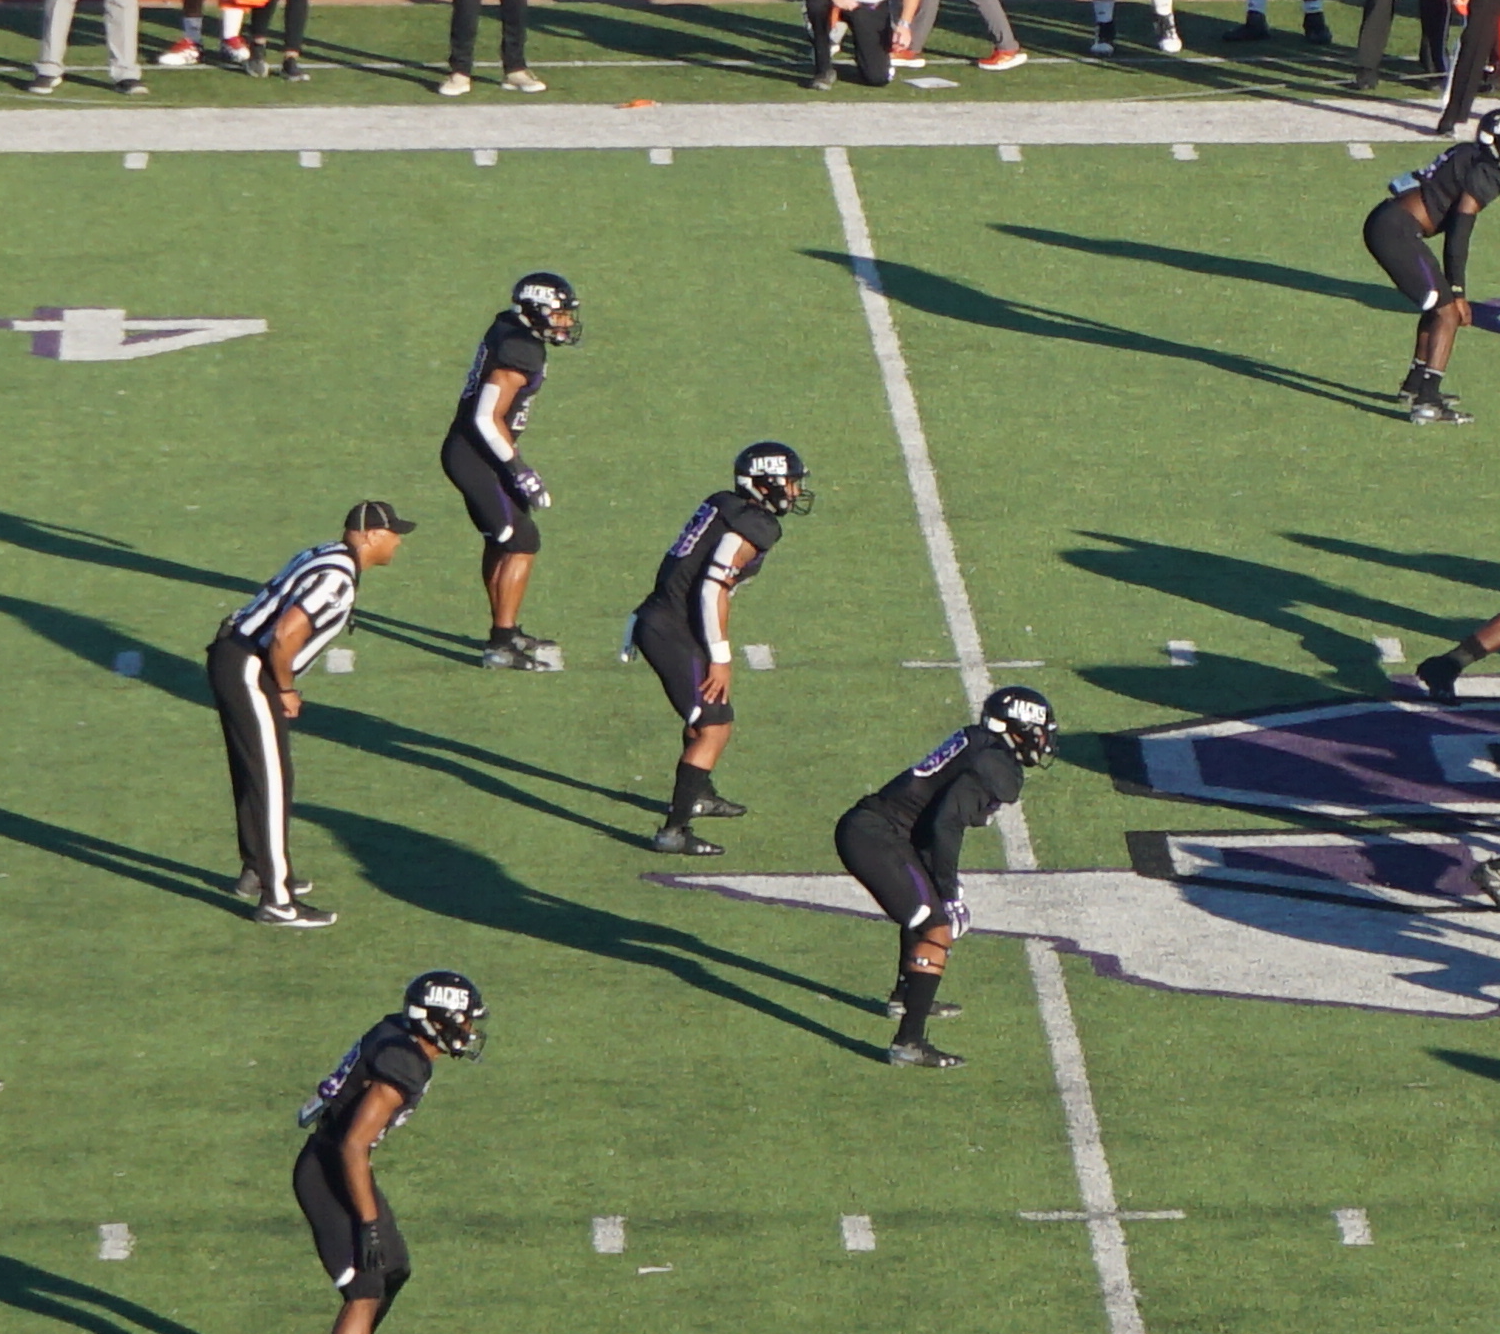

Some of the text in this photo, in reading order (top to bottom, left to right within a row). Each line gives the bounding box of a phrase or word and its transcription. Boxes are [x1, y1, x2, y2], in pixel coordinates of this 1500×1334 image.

[749, 455, 789, 476] JACKS
[1007, 701, 1049, 726] JACKS
[424, 987, 470, 1012] JACKS
